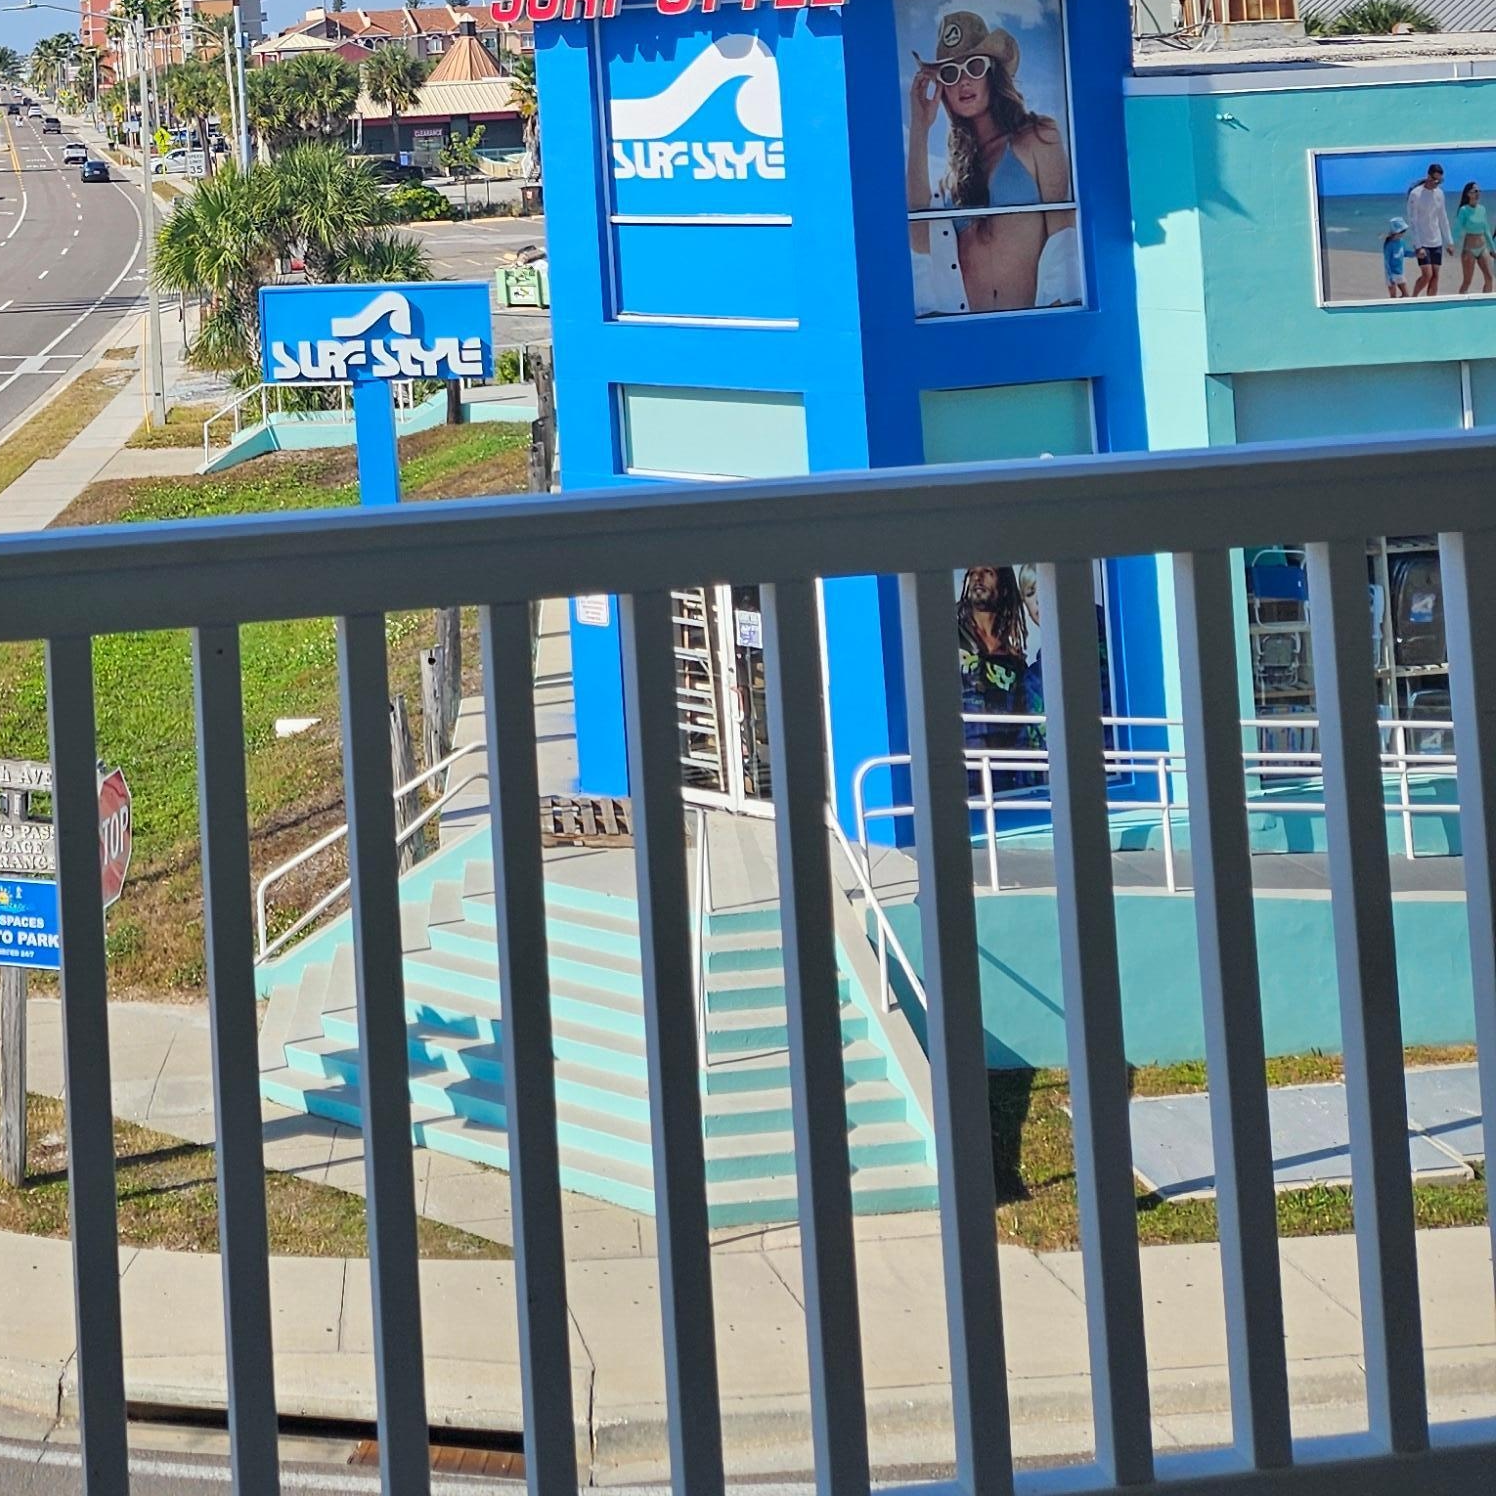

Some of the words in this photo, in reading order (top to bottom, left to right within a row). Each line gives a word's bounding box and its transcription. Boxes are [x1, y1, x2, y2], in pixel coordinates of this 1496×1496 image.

[190, 165, 203, 174] 35
[613, 140, 689, 179] SURF
[693, 140, 786, 180] STYLE
[271, 340, 367, 379] SURF
[371, 337, 483, 377] STYLE
[102, 804, 129, 865] TOP
[0, 915, 45, 929] SPACES
[17, 931, 60, 948] PARK
